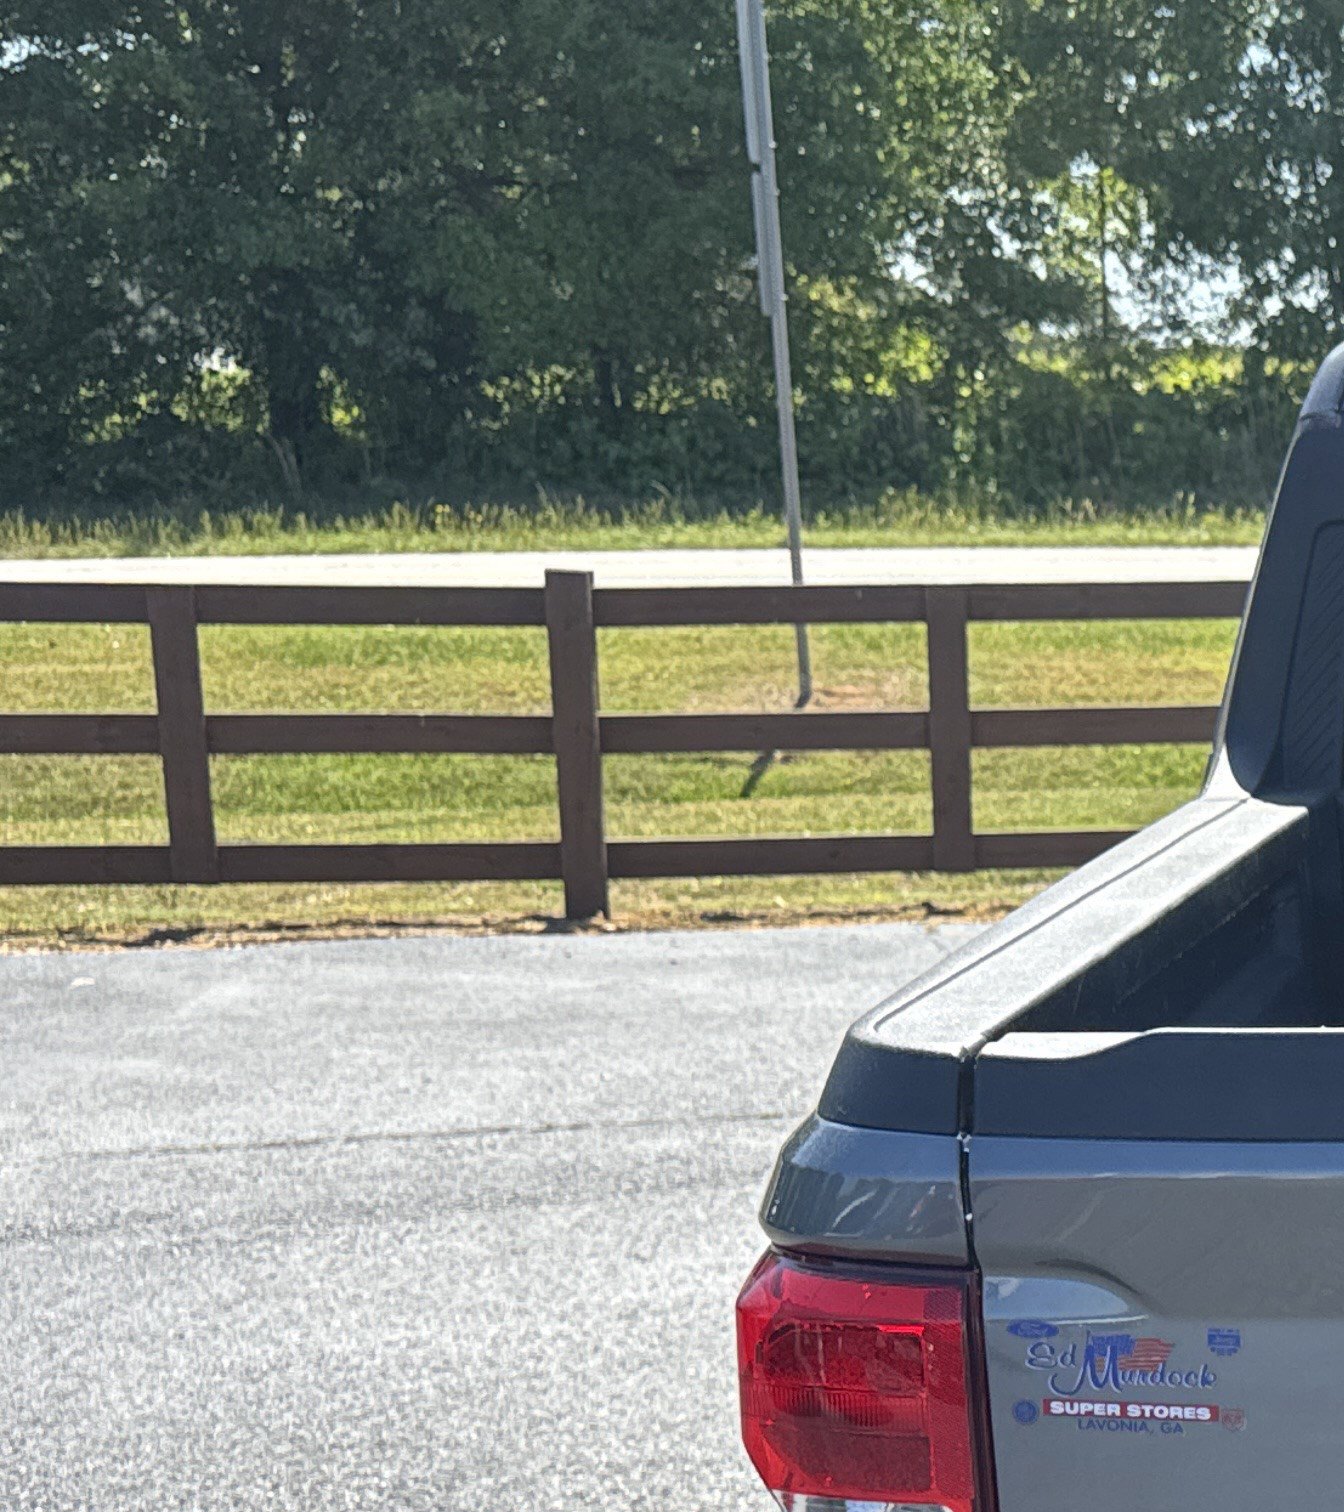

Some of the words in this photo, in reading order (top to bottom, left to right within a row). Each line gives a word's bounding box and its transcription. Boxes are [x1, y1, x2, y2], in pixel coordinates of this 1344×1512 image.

[1025, 1341, 1077, 1370] Ed
[1048, 1330, 1217, 1396] Murdock
[1049, 1401, 1121, 1417] SUPER
[1126, 1403, 1212, 1421] STORES
[1077, 1418, 1154, 1435] LAVONIA,
[1160, 1421, 1184, 1435] GA
